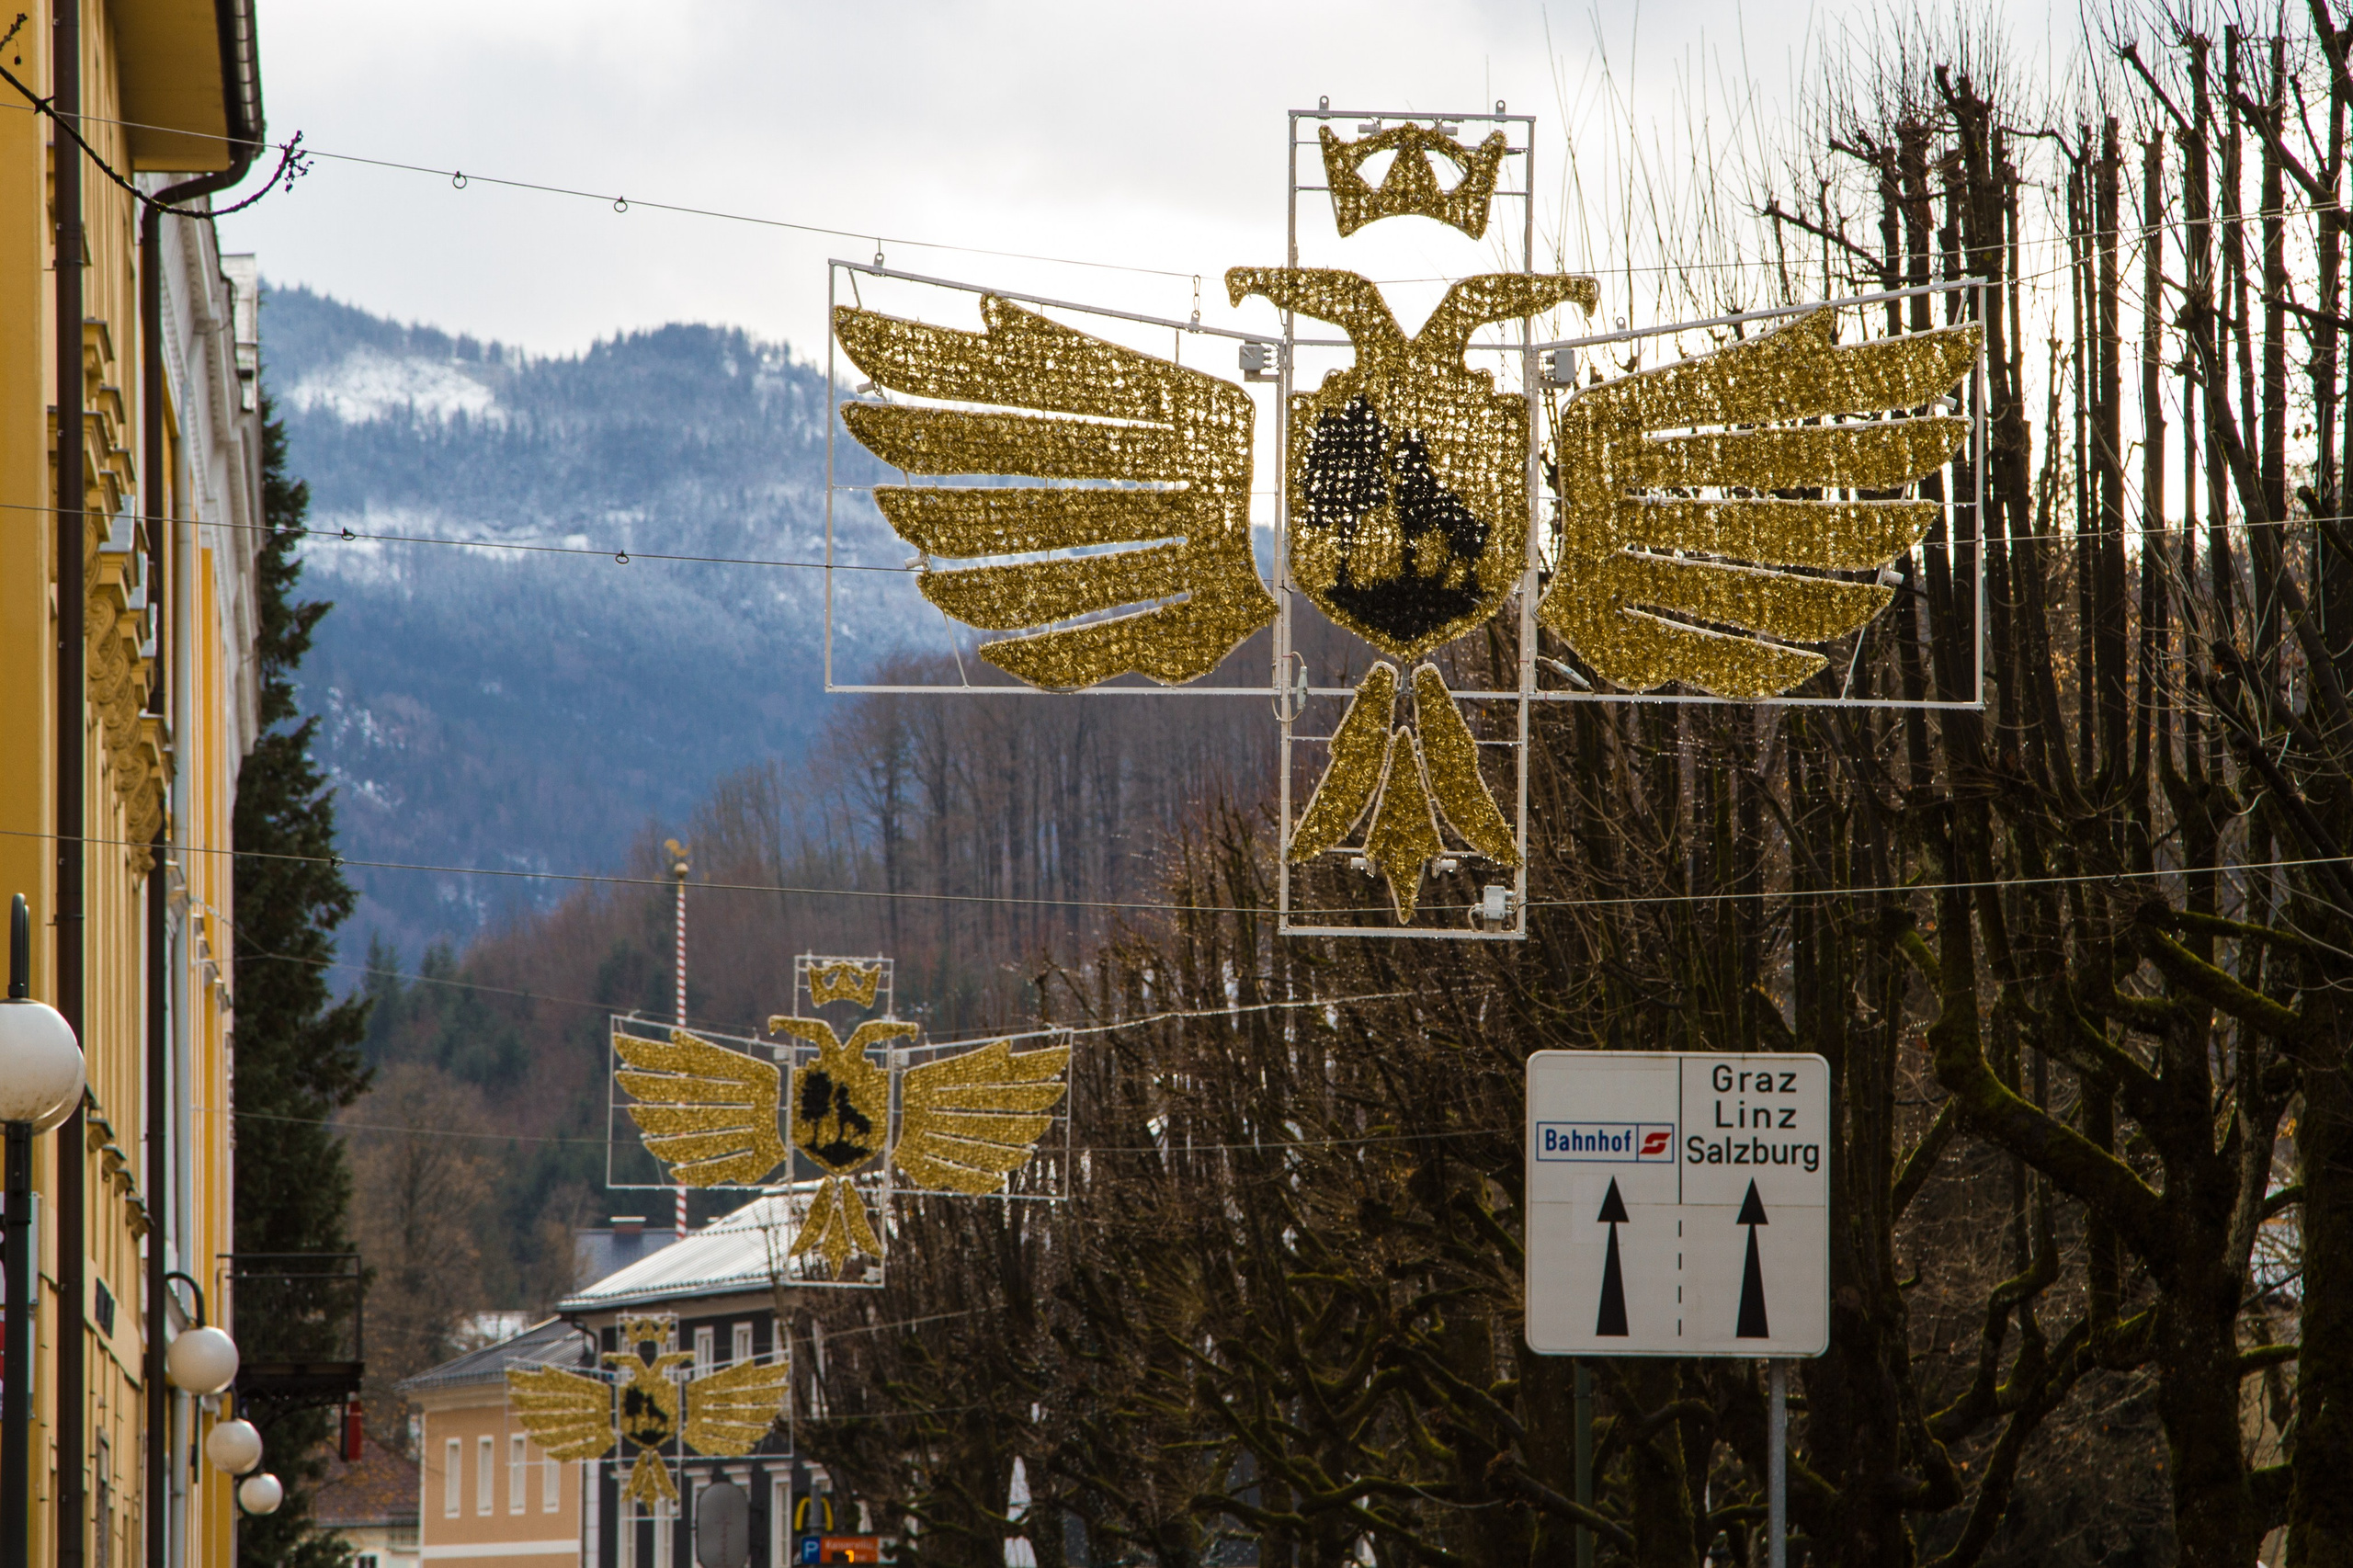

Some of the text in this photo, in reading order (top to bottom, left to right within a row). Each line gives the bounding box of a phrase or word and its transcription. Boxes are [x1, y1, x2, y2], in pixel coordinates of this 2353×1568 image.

[1712, 1064, 1796, 1093] Graz
[1716, 1100, 1796, 1129] Linz
[1546, 1129, 1631, 1152] Bahnhof
[1687, 1136, 1819, 1173] Salzburg
[805, 1541, 819, 1559] P
